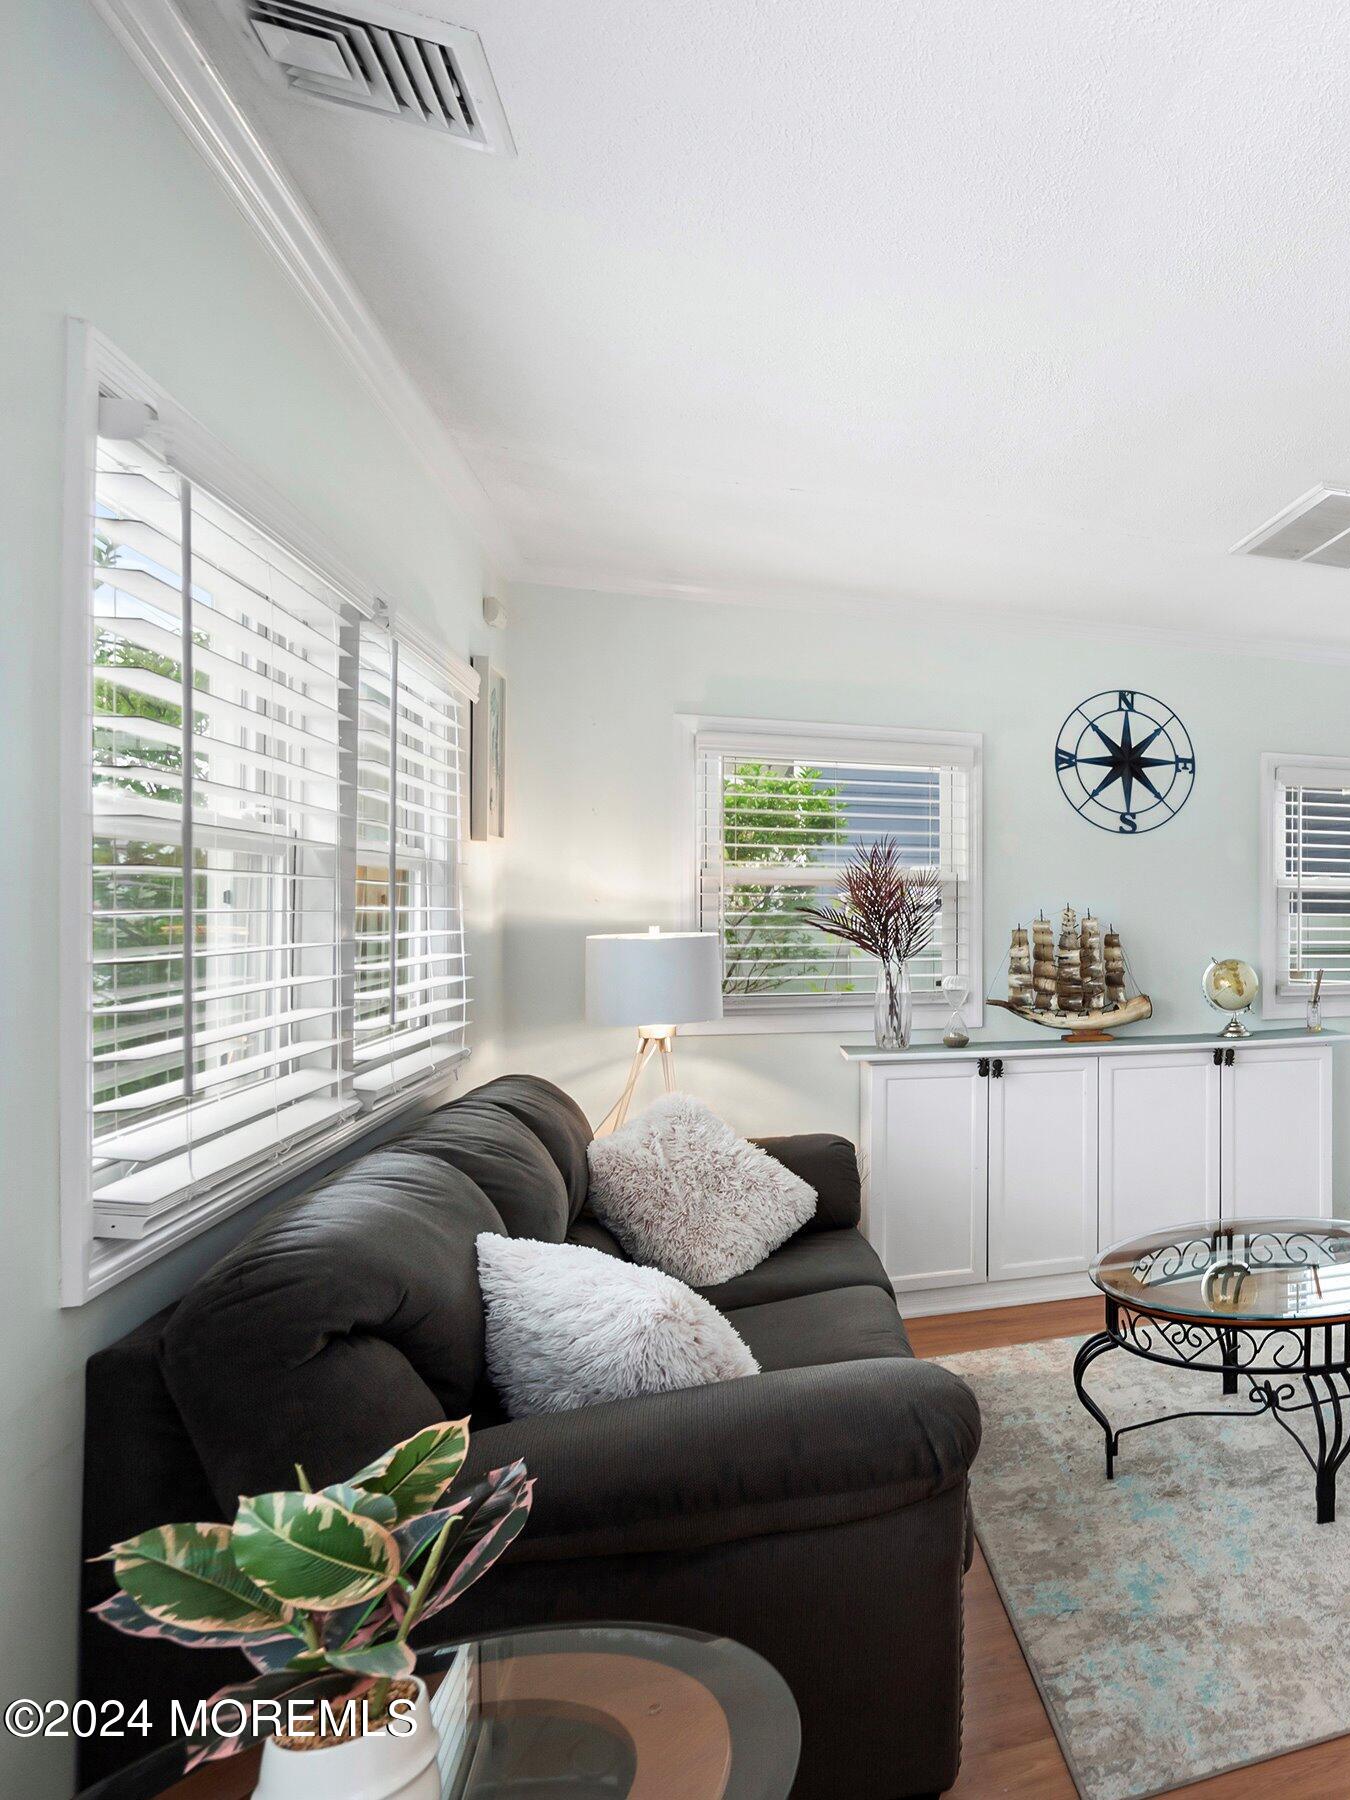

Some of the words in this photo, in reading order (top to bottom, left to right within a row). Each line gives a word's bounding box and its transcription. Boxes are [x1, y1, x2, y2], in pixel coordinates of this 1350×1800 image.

[1117, 690, 1135, 712] N
[1175, 754, 1195, 774] E
[1119, 812, 1137, 833] S
